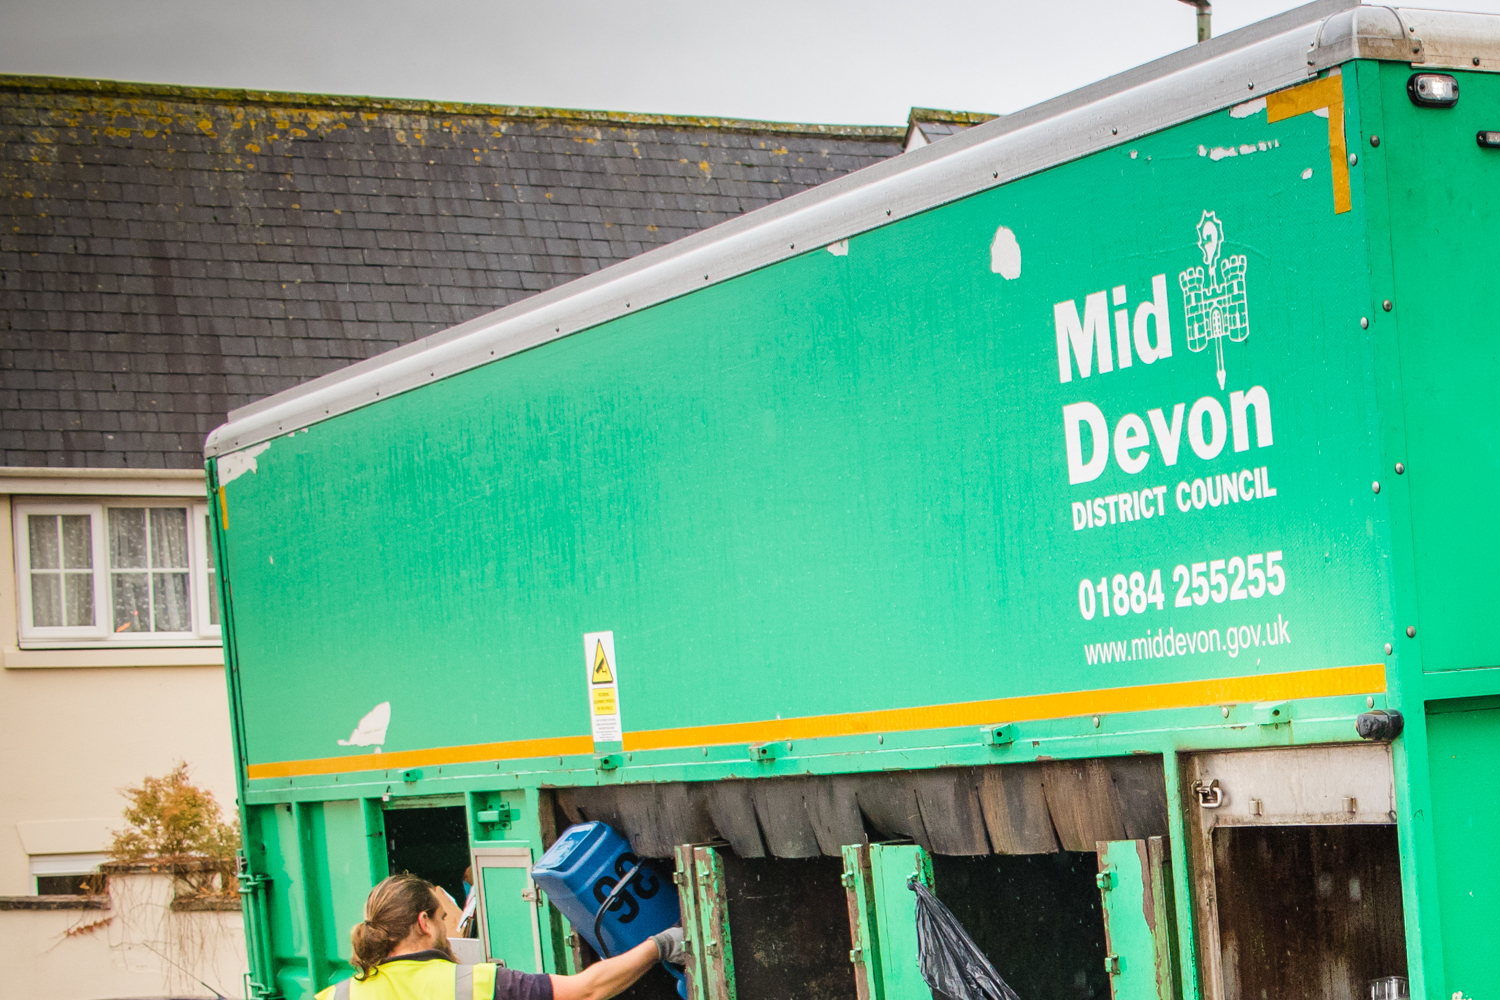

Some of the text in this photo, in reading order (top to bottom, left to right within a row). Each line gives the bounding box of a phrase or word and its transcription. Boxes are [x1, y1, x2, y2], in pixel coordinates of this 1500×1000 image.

[1053, 273, 1173, 384] Mid
[1062, 384, 1274, 486] Devon
[1071, 467, 1277, 531] DISTRICT COUNCIL
[1078, 550, 1286, 621] 01884 255255
[1084, 613, 1291, 666] www.middevon.gov.uk
